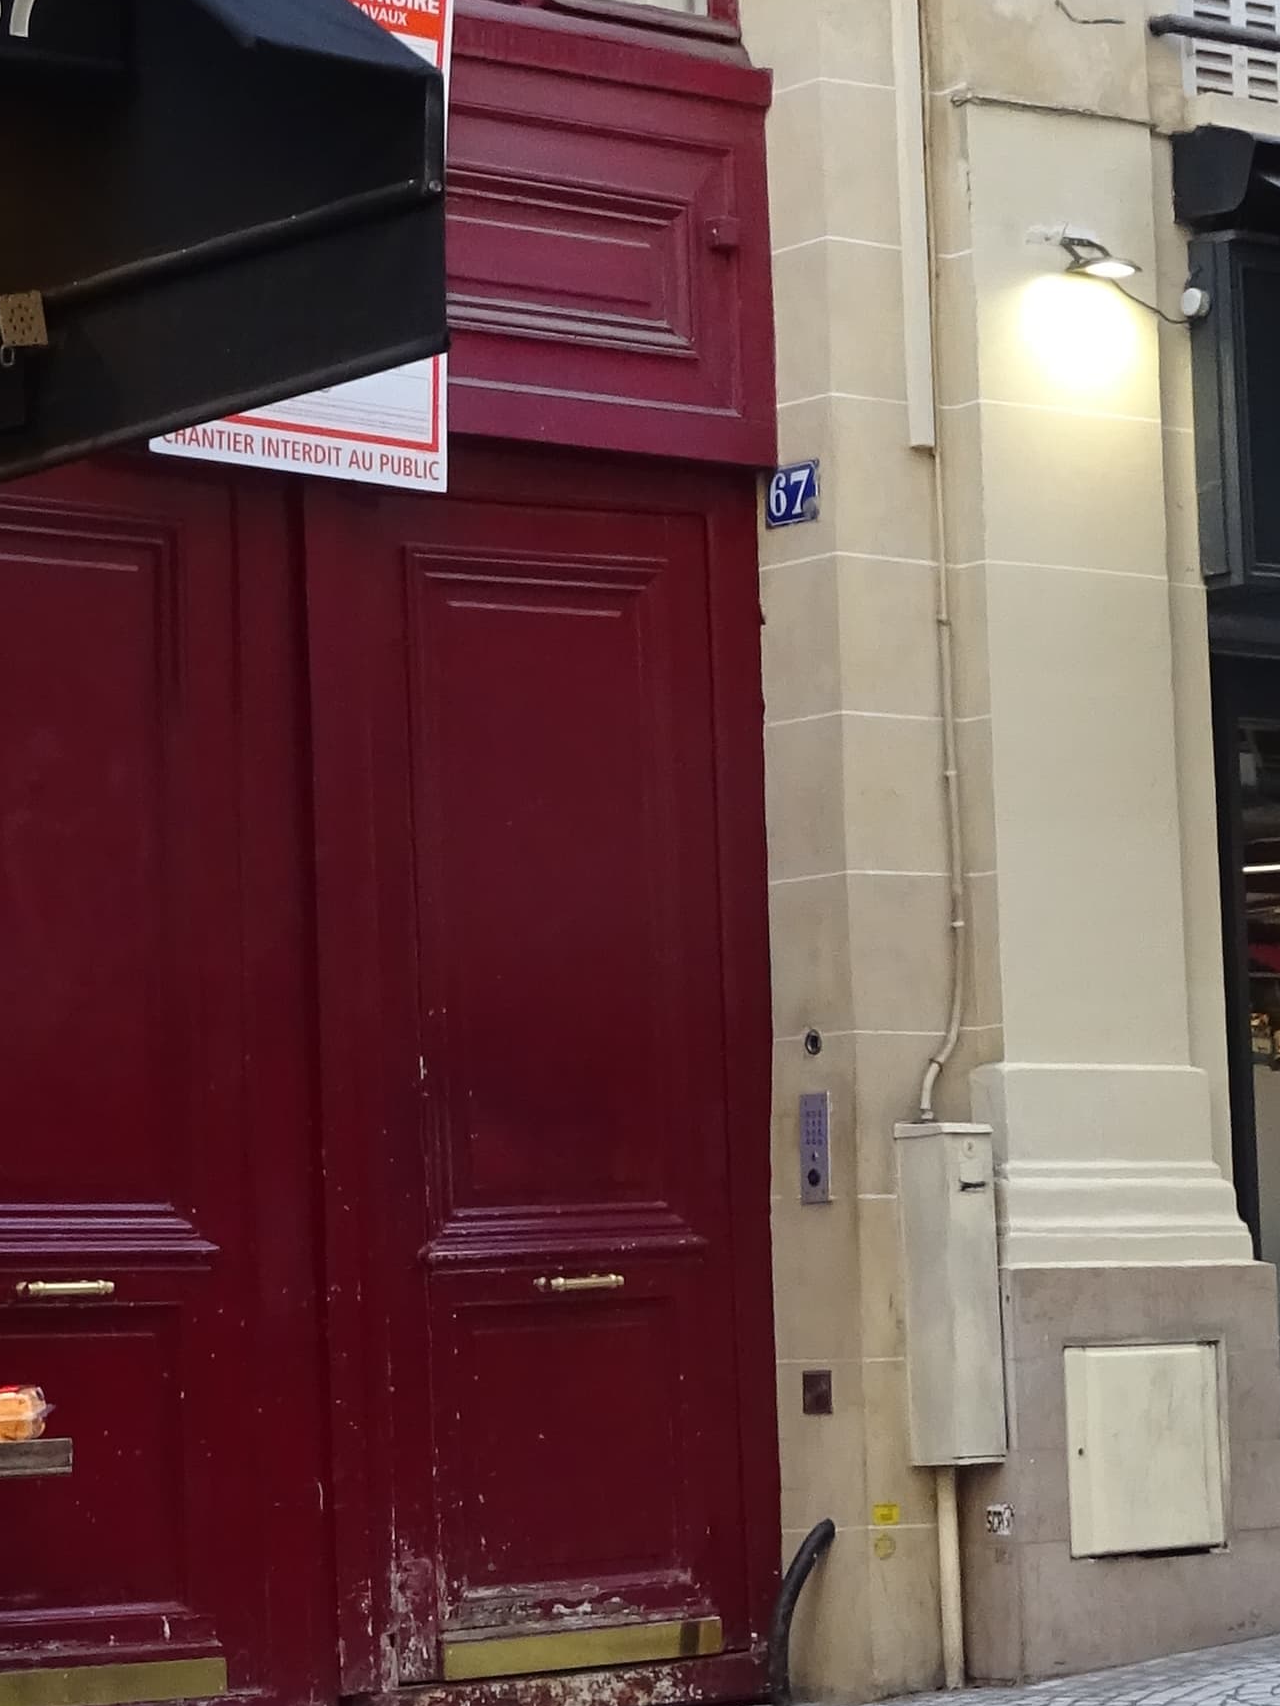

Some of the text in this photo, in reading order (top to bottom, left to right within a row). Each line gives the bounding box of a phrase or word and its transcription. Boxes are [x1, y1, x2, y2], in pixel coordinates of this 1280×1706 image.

[353, 1, 408, 27] AVAUX
[162, 426, 440, 481] CHANTIER INTERDIT AU PUBLIC
[769, 468, 810, 517] 67
